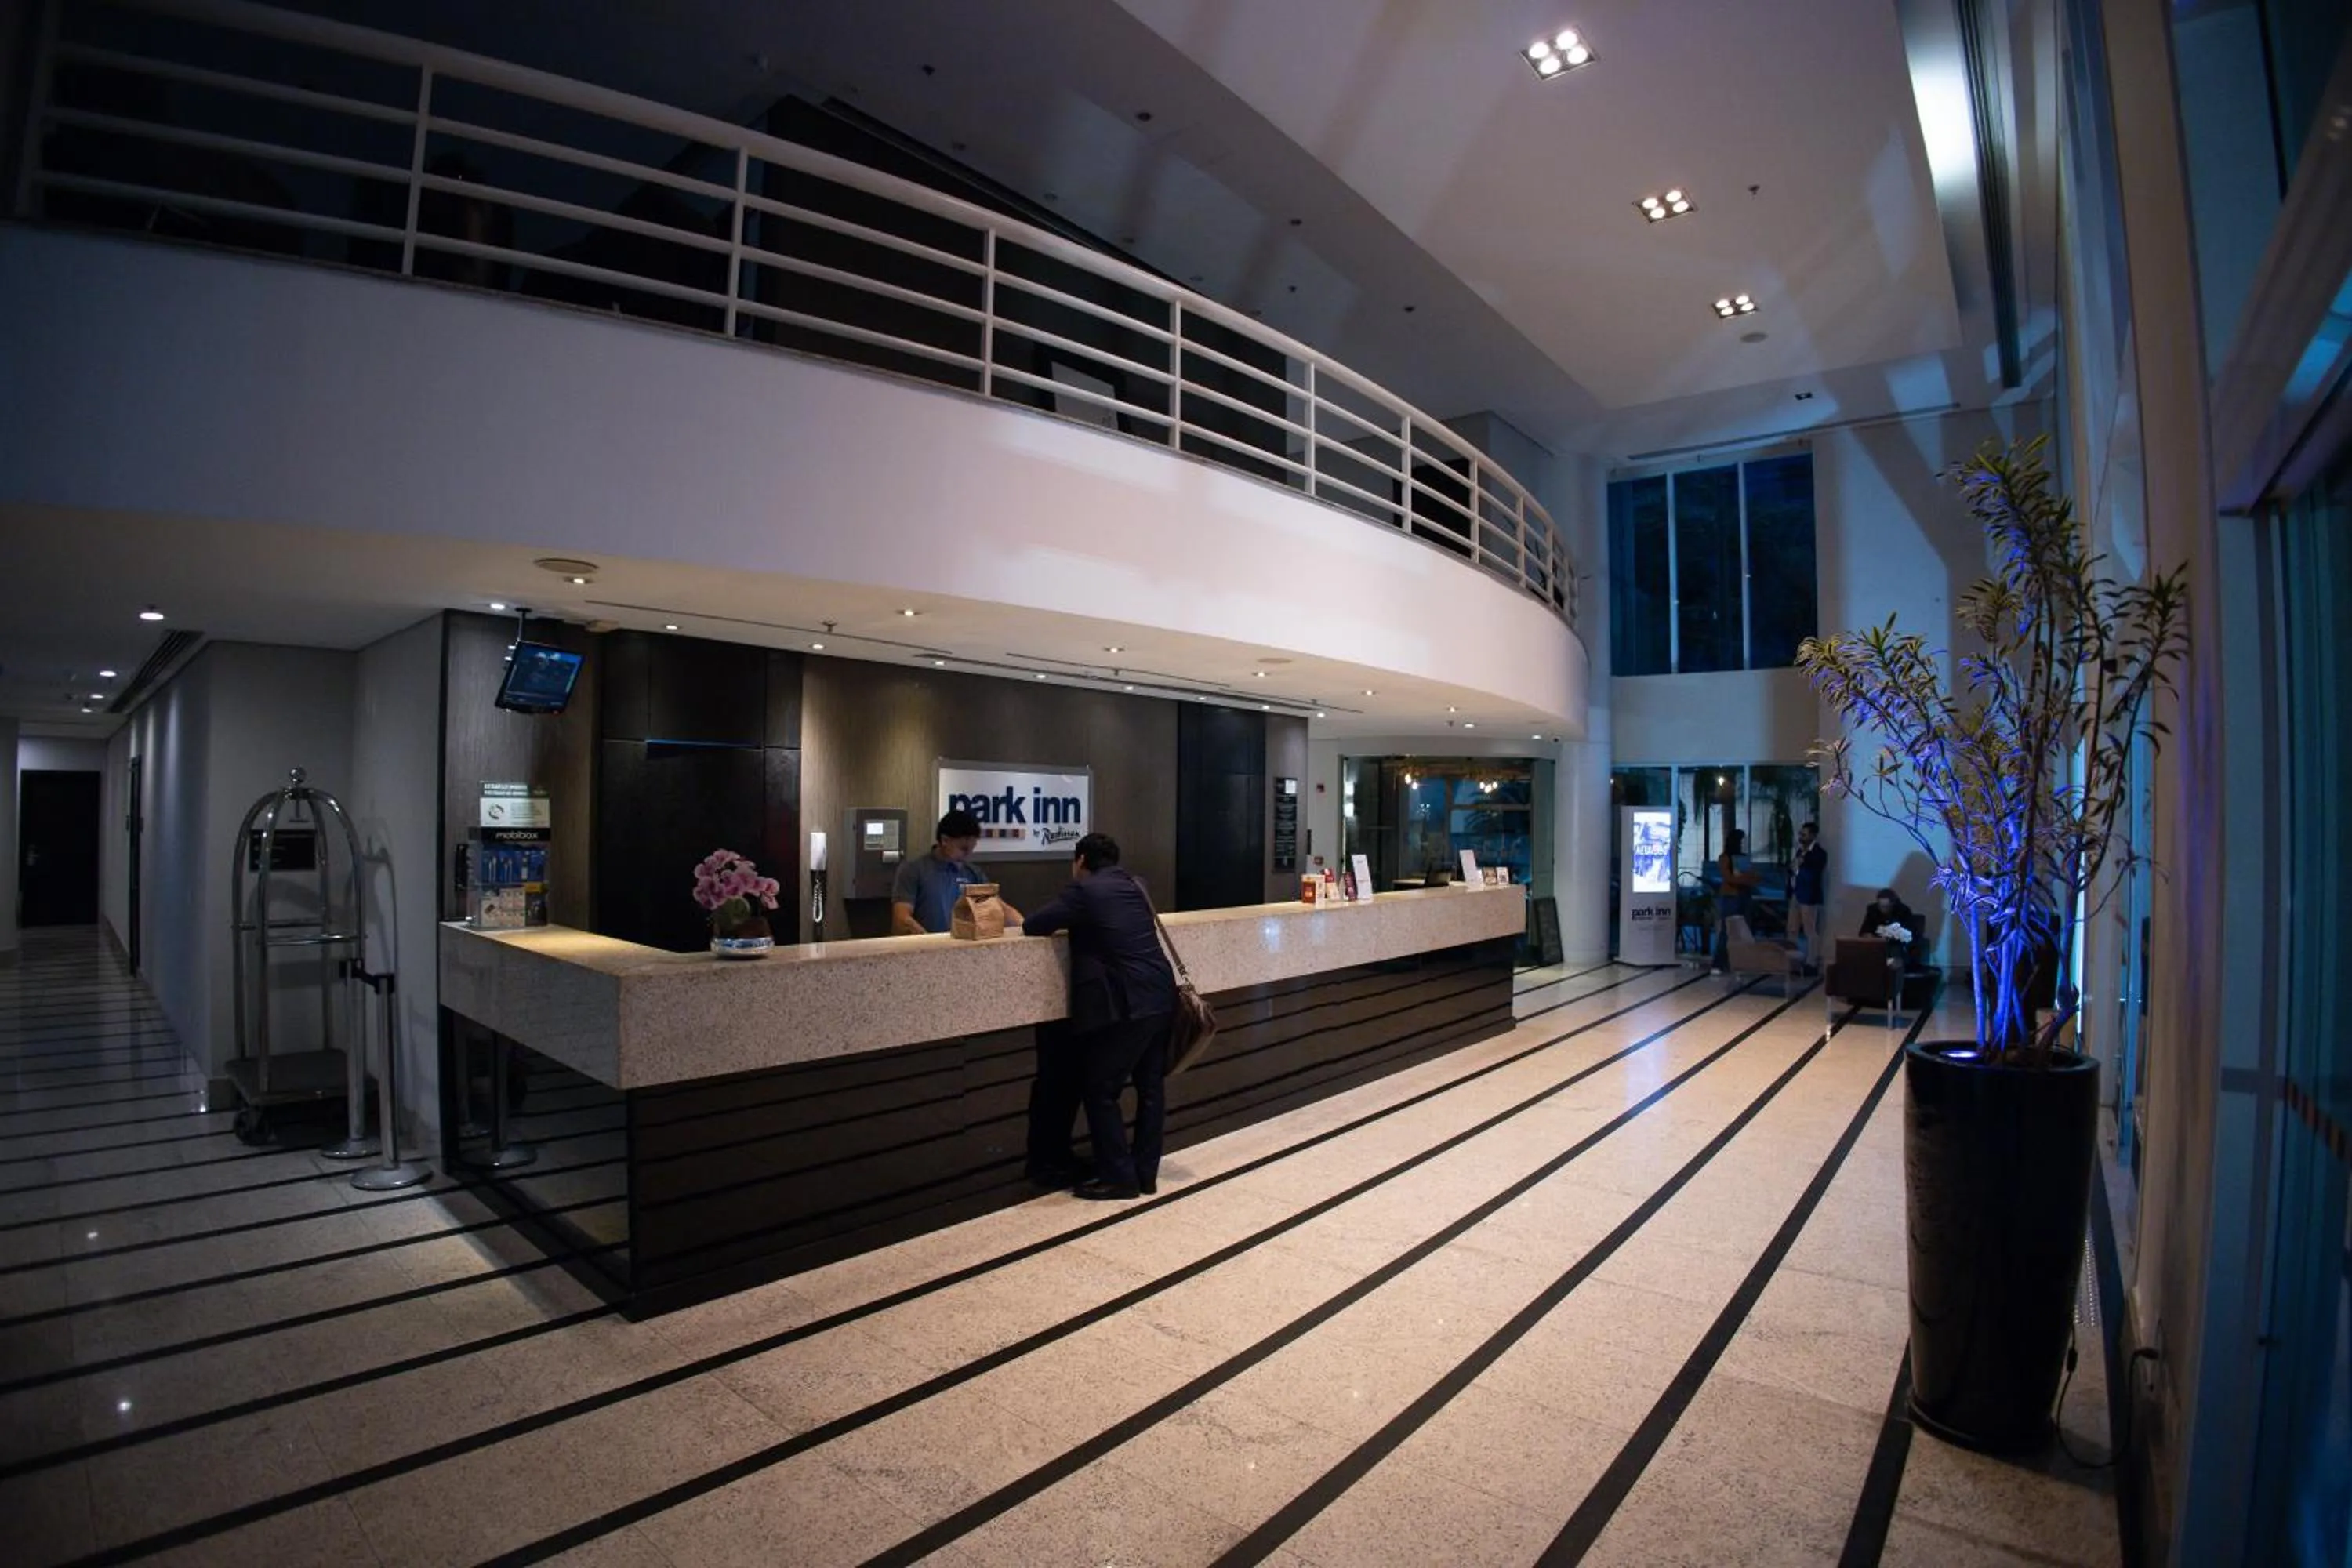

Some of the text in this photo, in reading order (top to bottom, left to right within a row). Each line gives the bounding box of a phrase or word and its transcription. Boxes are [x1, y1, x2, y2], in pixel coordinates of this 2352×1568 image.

[949, 786, 1081, 823] park inn
[1632, 906, 1671, 921] park inn
